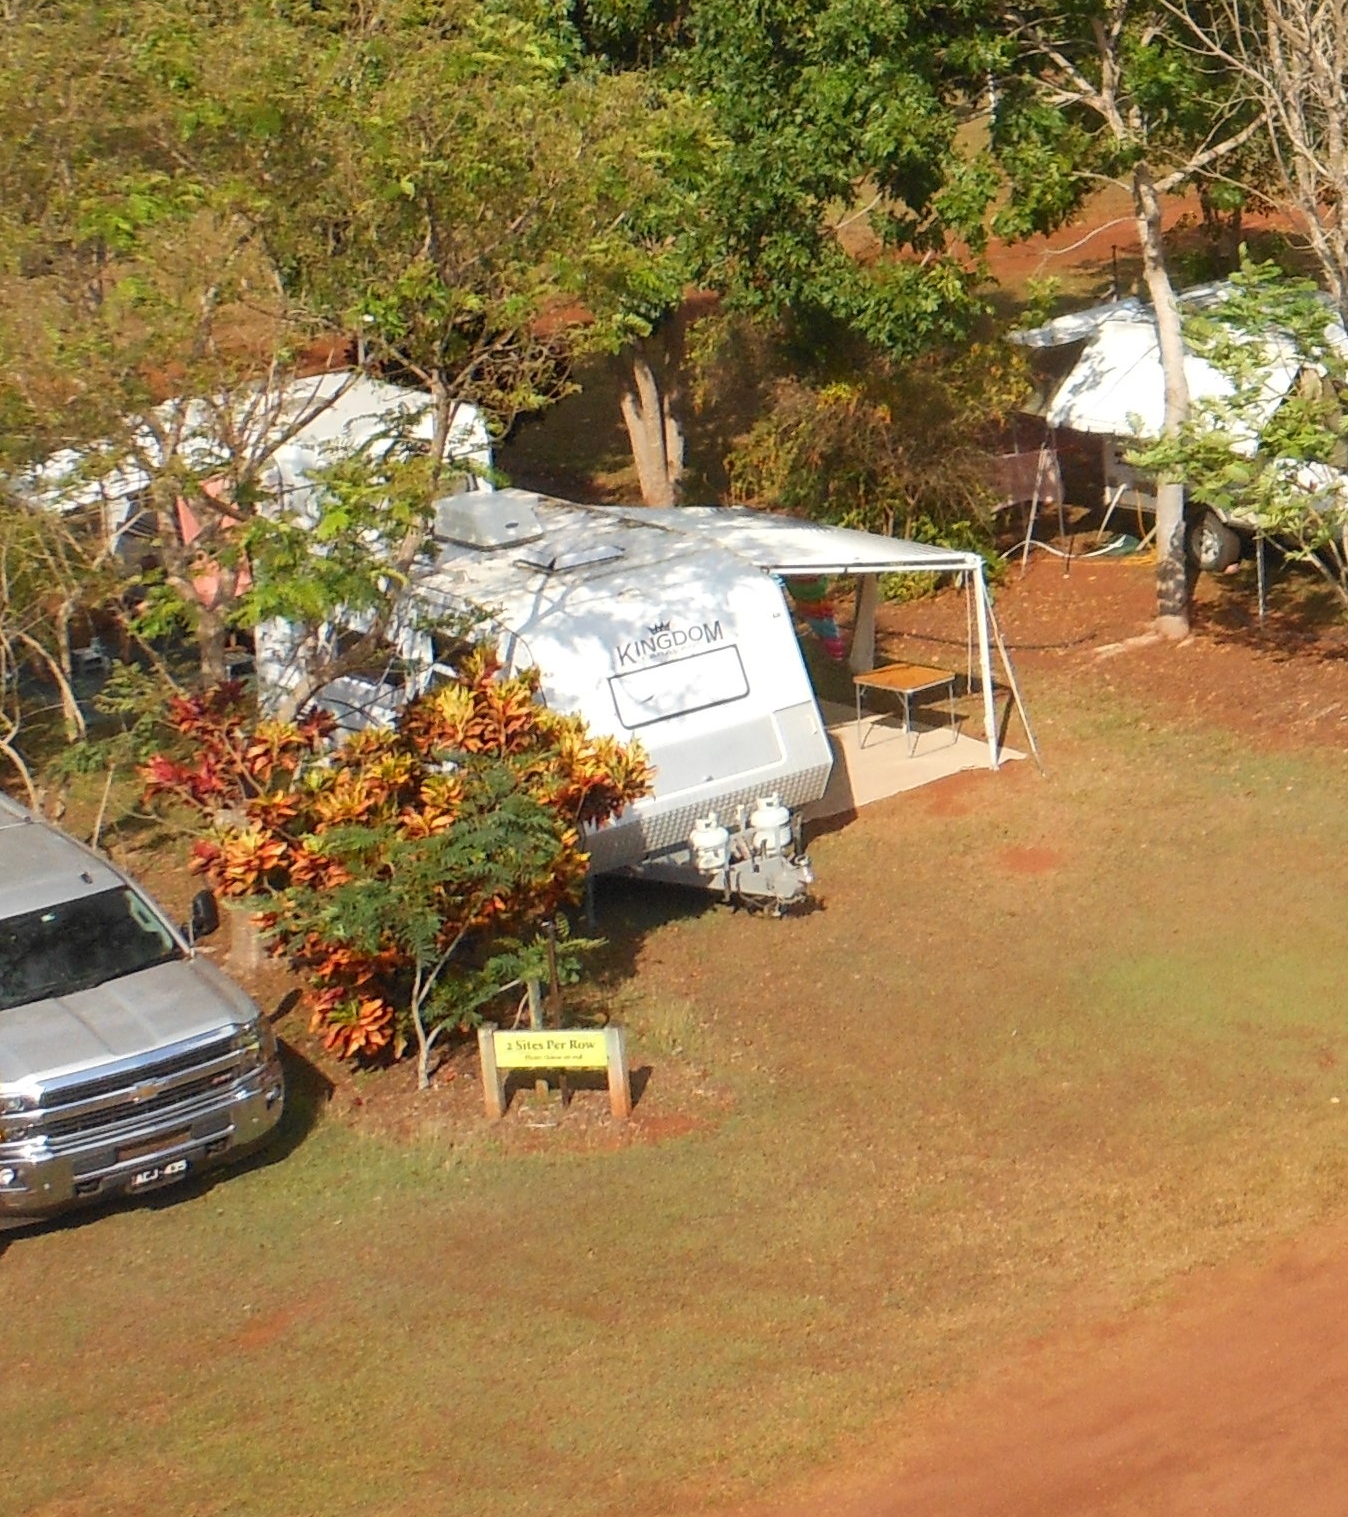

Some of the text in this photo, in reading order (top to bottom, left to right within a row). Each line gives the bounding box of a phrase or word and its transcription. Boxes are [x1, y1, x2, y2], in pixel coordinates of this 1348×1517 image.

[616, 620, 724, 666] KINGDOM
[506, 1039, 596, 1051] 2 Sites Per Row
